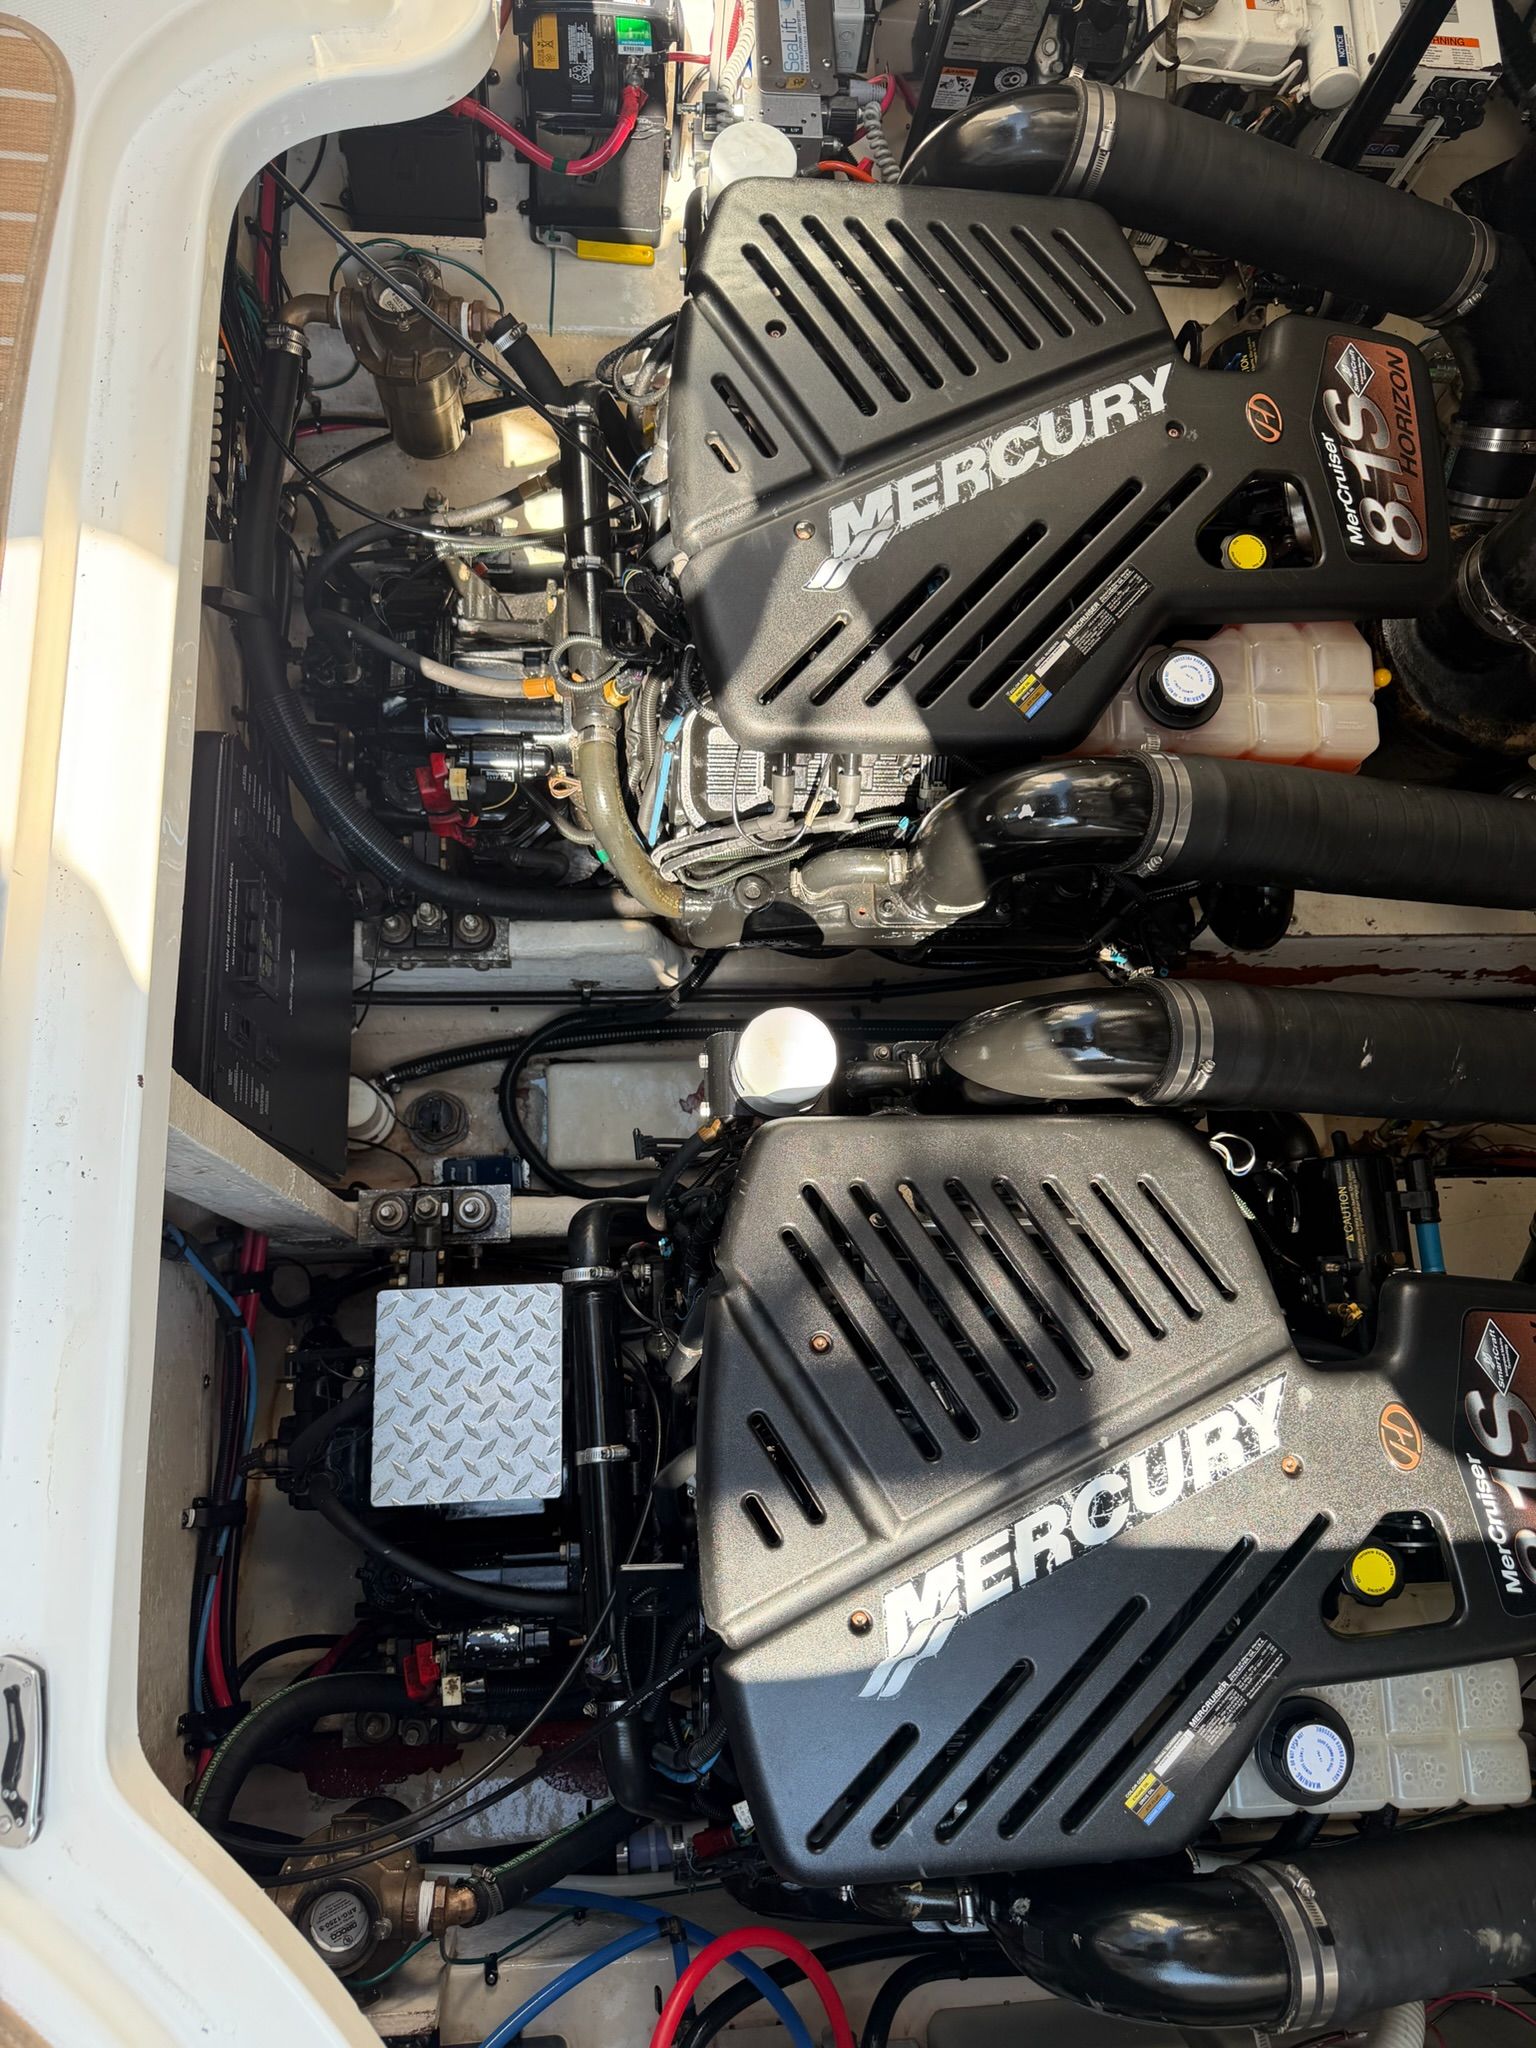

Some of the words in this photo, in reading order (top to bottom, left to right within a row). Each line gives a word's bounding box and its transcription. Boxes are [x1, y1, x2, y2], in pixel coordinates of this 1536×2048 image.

[781, 17, 799, 71] SeaLift
[1336, 34, 1346, 58] NOTICE
[1432, 36, 1464, 46] RNING
[1349, 348, 1360, 391] SmartCraft
[1386, 350, 1418, 478] HORIZON
[829, 362, 1173, 558] MERCURY
[1322, 388, 1423, 556] 8.1S
[1321, 432, 1365, 546] MerCruiser
[1064, 601, 1101, 639] MERCRUISER
[1338, 1186, 1354, 1233] CAUTION
[1489, 1329, 1505, 1388] SmartCraft
[886, 1371, 1288, 1658] MERCURY
[1466, 1452, 1523, 1594] MerCruiser
[1188, 1680, 1230, 1729] MERCRUISER
[193, 1750, 225, 1806] PREMIUM
[219, 1713, 254, 1752] MARINE
[1295, 1772, 1321, 1789] WARNING
[503, 1851, 528, 1870] WATER
